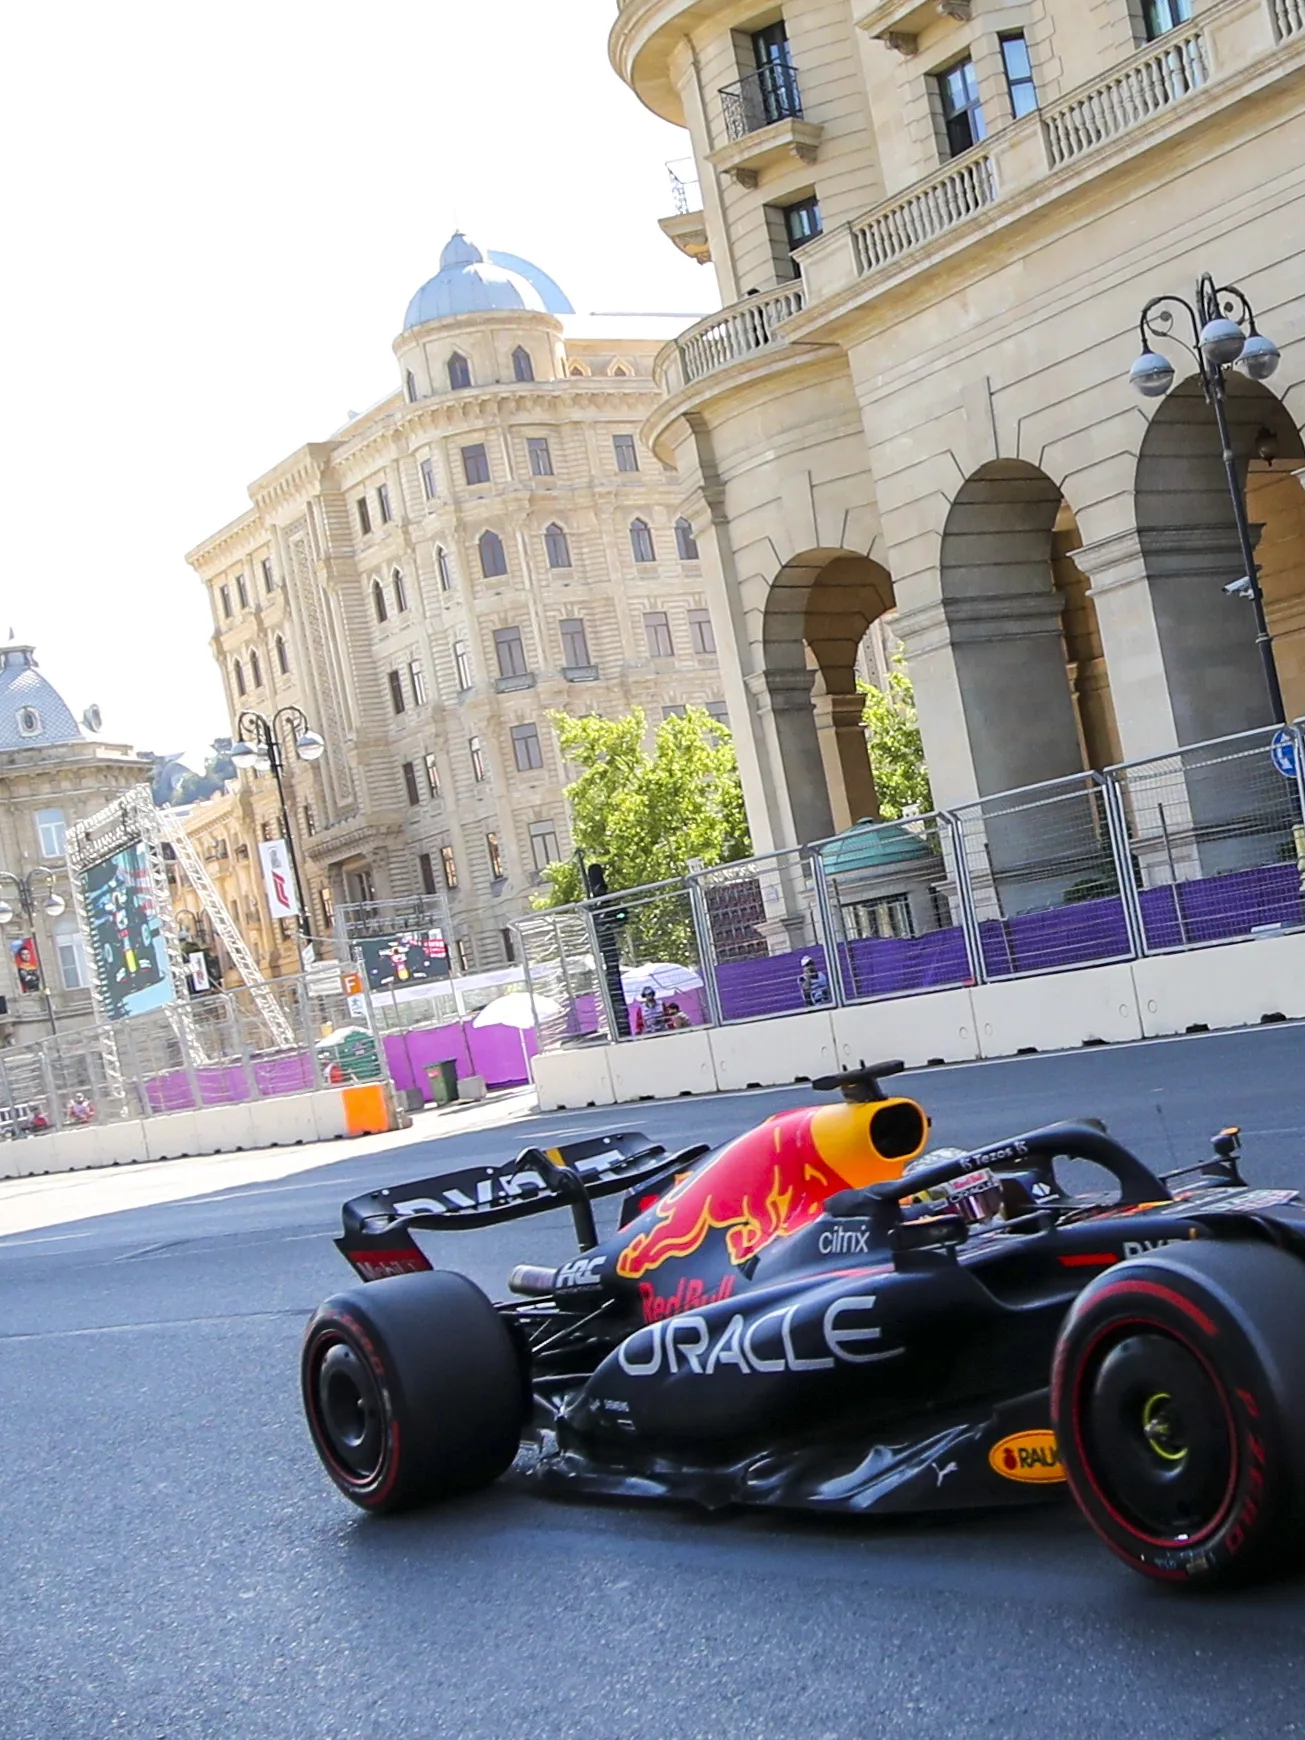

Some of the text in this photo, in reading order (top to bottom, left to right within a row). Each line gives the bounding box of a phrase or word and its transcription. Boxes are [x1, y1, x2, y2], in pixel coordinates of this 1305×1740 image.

[344, 976, 356, 993] F
[973, 1147, 1014, 1166] Tezos
[819, 1226, 870, 1254] citrix
[618, 1295, 906, 1377] ORACLE
